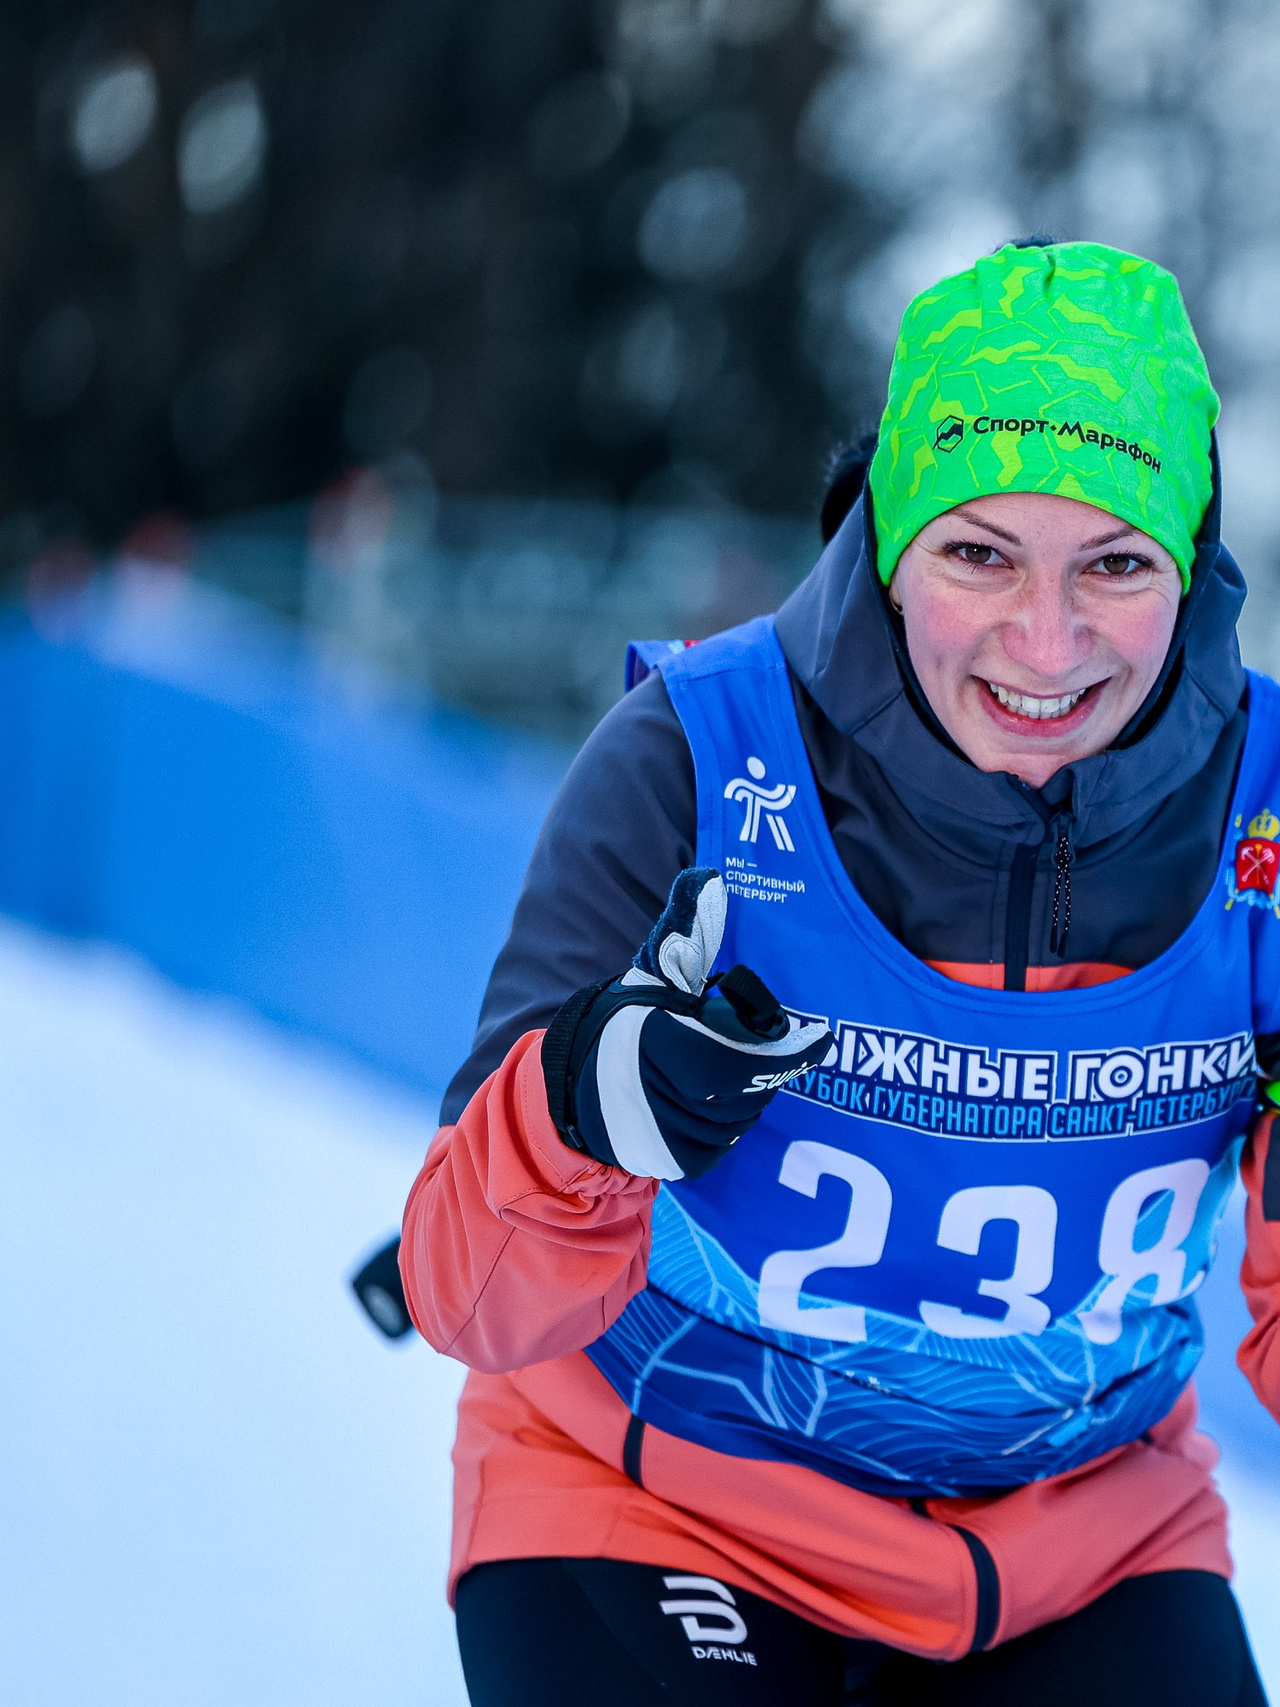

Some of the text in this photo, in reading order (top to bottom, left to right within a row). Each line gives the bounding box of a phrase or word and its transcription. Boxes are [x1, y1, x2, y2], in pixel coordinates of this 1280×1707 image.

[726, 857, 745, 869] МЫ
[726, 870, 806, 893] СПОРТИВНЫЙ
[726, 883, 788, 904] ПЕТЕРБУРГ
[787, 1014, 1257, 1101] ЫЖНЫЕ ГОНКИ
[873, 1086, 1043, 1136] ГУБЕРНАТОРА
[758, 1139, 1211, 1345] 238
